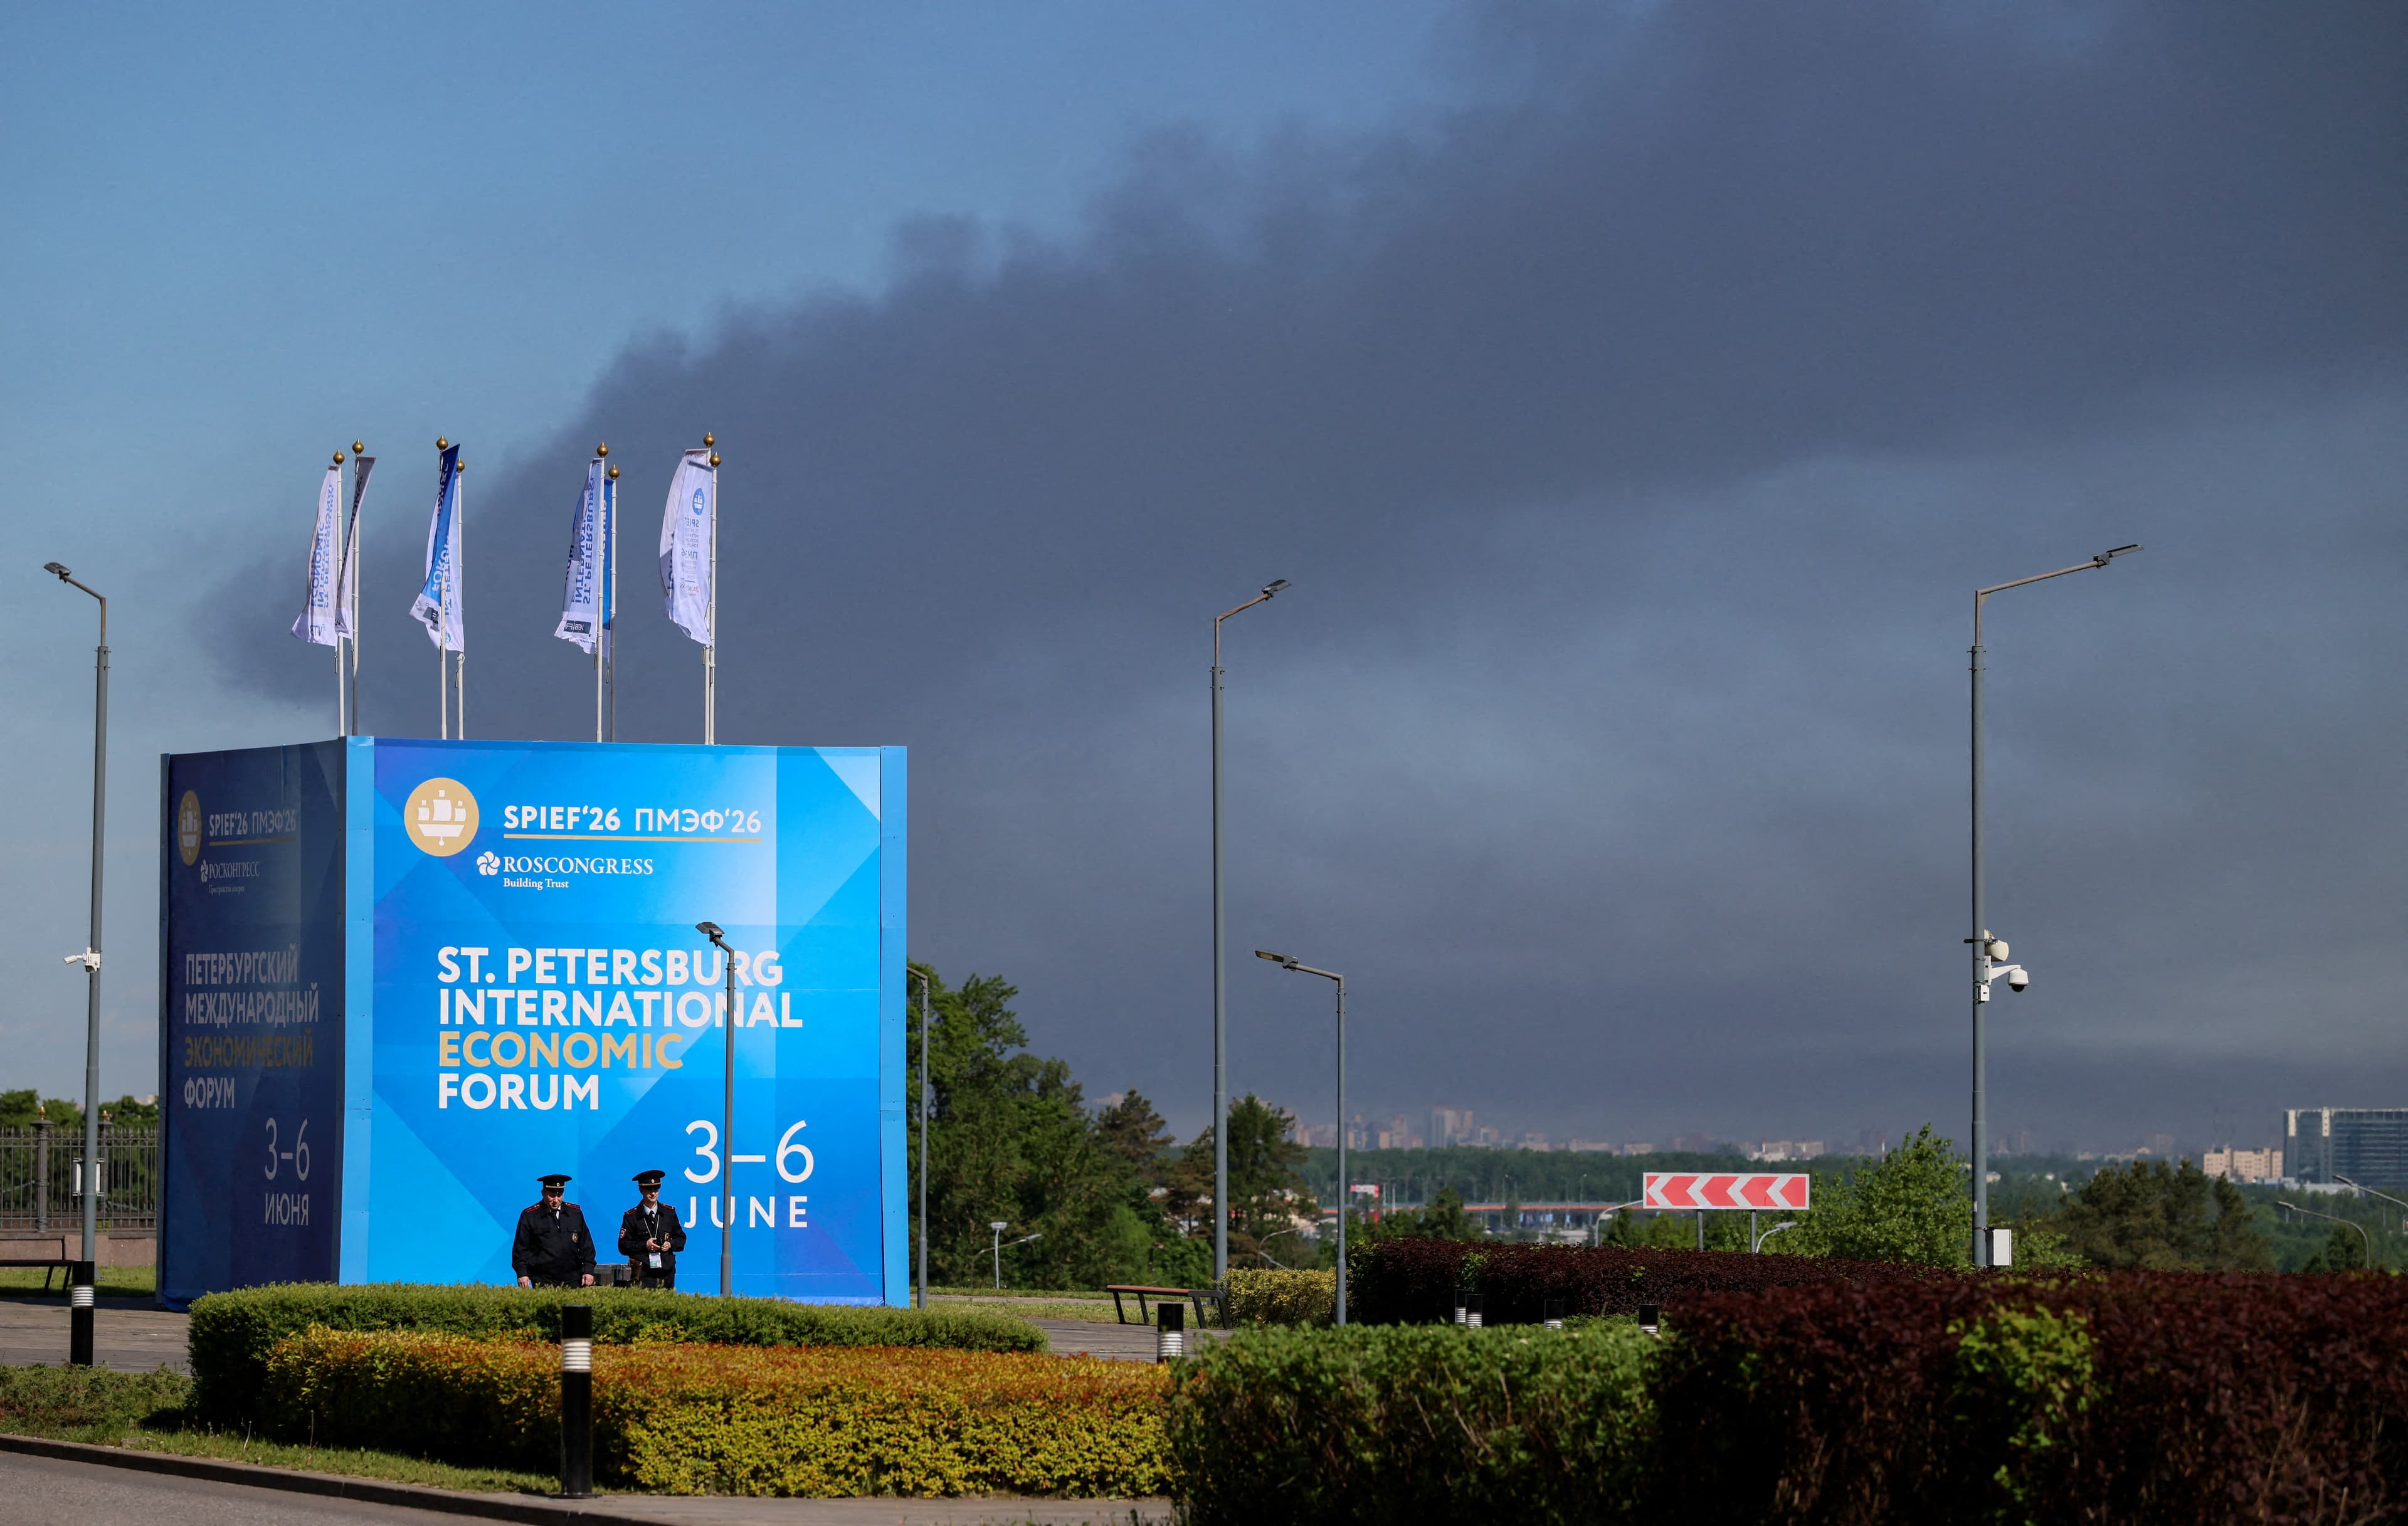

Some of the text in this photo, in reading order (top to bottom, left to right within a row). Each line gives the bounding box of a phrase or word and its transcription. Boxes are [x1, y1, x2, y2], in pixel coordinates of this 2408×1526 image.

[209, 861, 261, 878] РОСКОНГРЕСС
[504, 856, 653, 875] ROSCONGRESS
[504, 878, 569, 891] Building Trust
[186, 942, 298, 985] ПЕТЕРБУРГСКИЙ
[437, 946, 783, 987] ST. PETERSBURG
[186, 982, 319, 1029] МЕЖДУНАРОДНЫЙ
[440, 988, 803, 1028] INTERNATIONAL
[185, 1028, 314, 1068] ЭКОНОМИЧЕСКИЙ
[439, 1031, 684, 1070] ECONOMIC
[184, 1077, 235, 1109] ФОРУМ
[438, 1073, 599, 1110] FORUM
[265, 1192, 310, 1226] ИЮНЯ
[684, 1196, 808, 1229] JUNE
